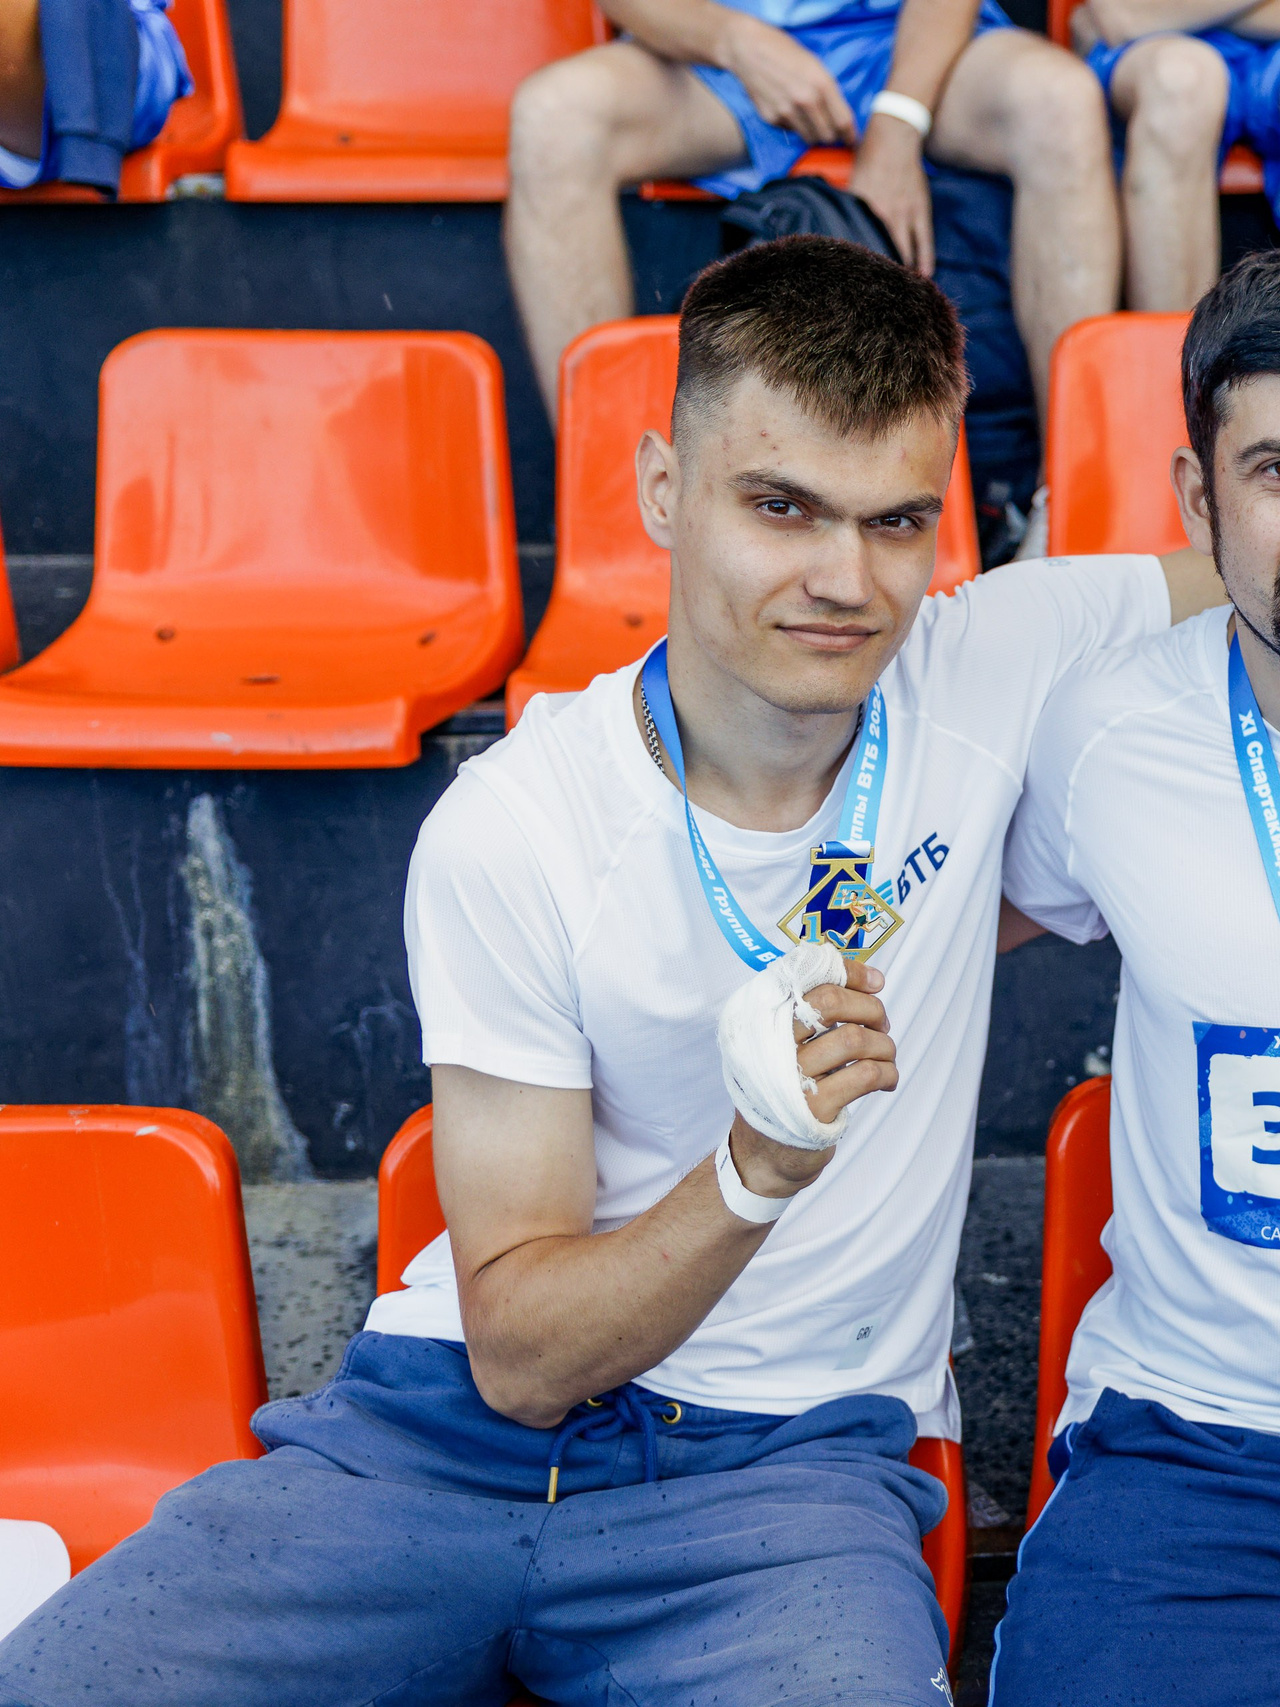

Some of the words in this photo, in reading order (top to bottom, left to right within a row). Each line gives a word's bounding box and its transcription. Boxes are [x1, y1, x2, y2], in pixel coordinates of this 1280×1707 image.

[1238, 709, 1258, 737] XI
[856, 743, 879, 790] ВТБ
[897, 831, 950, 905] ВТБ
[712, 886, 761, 952] Группы
[806, 915, 820, 943] 1
